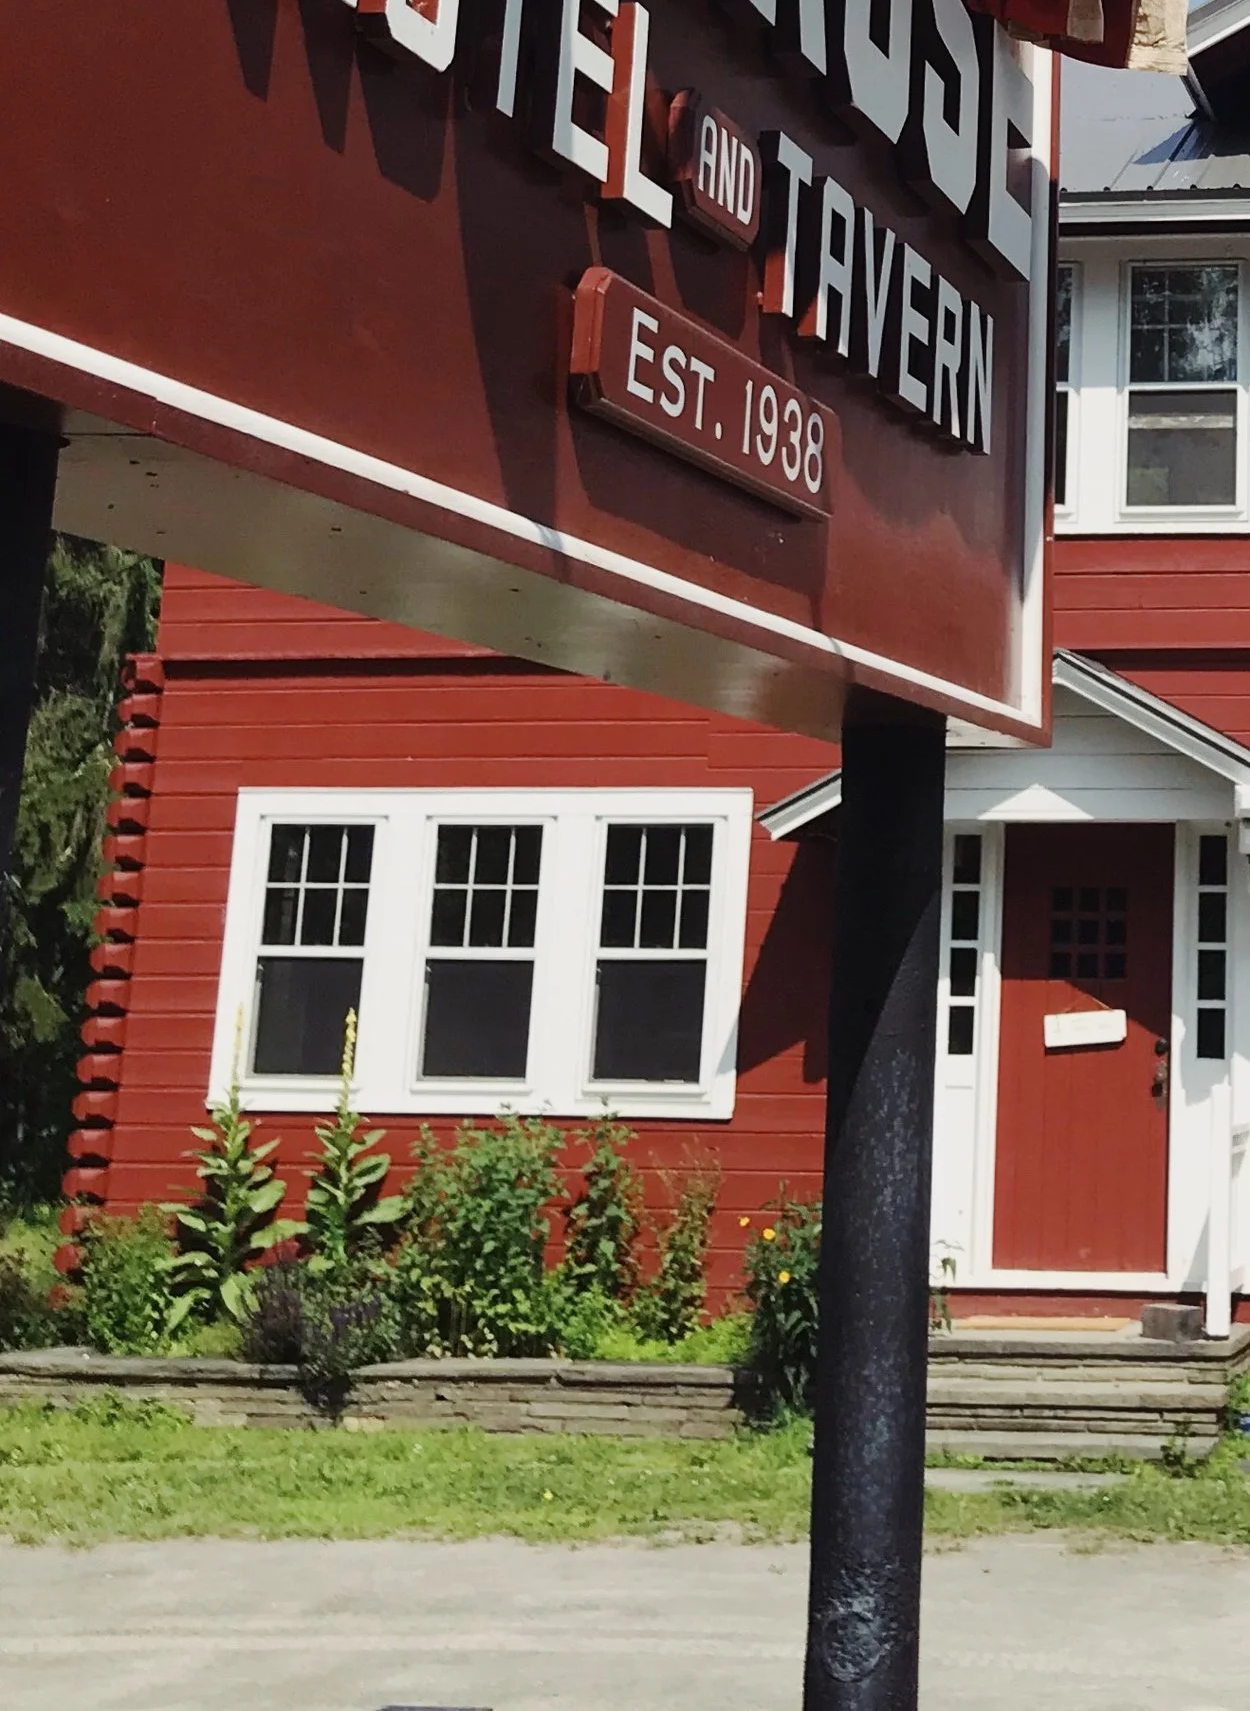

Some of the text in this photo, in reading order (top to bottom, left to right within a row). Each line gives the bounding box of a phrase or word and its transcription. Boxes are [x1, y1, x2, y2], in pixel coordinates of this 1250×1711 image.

[626, 307, 825, 495] EST. 1938
[697, 114, 755, 226] AND
[776, 130, 994, 456] TAVERN
